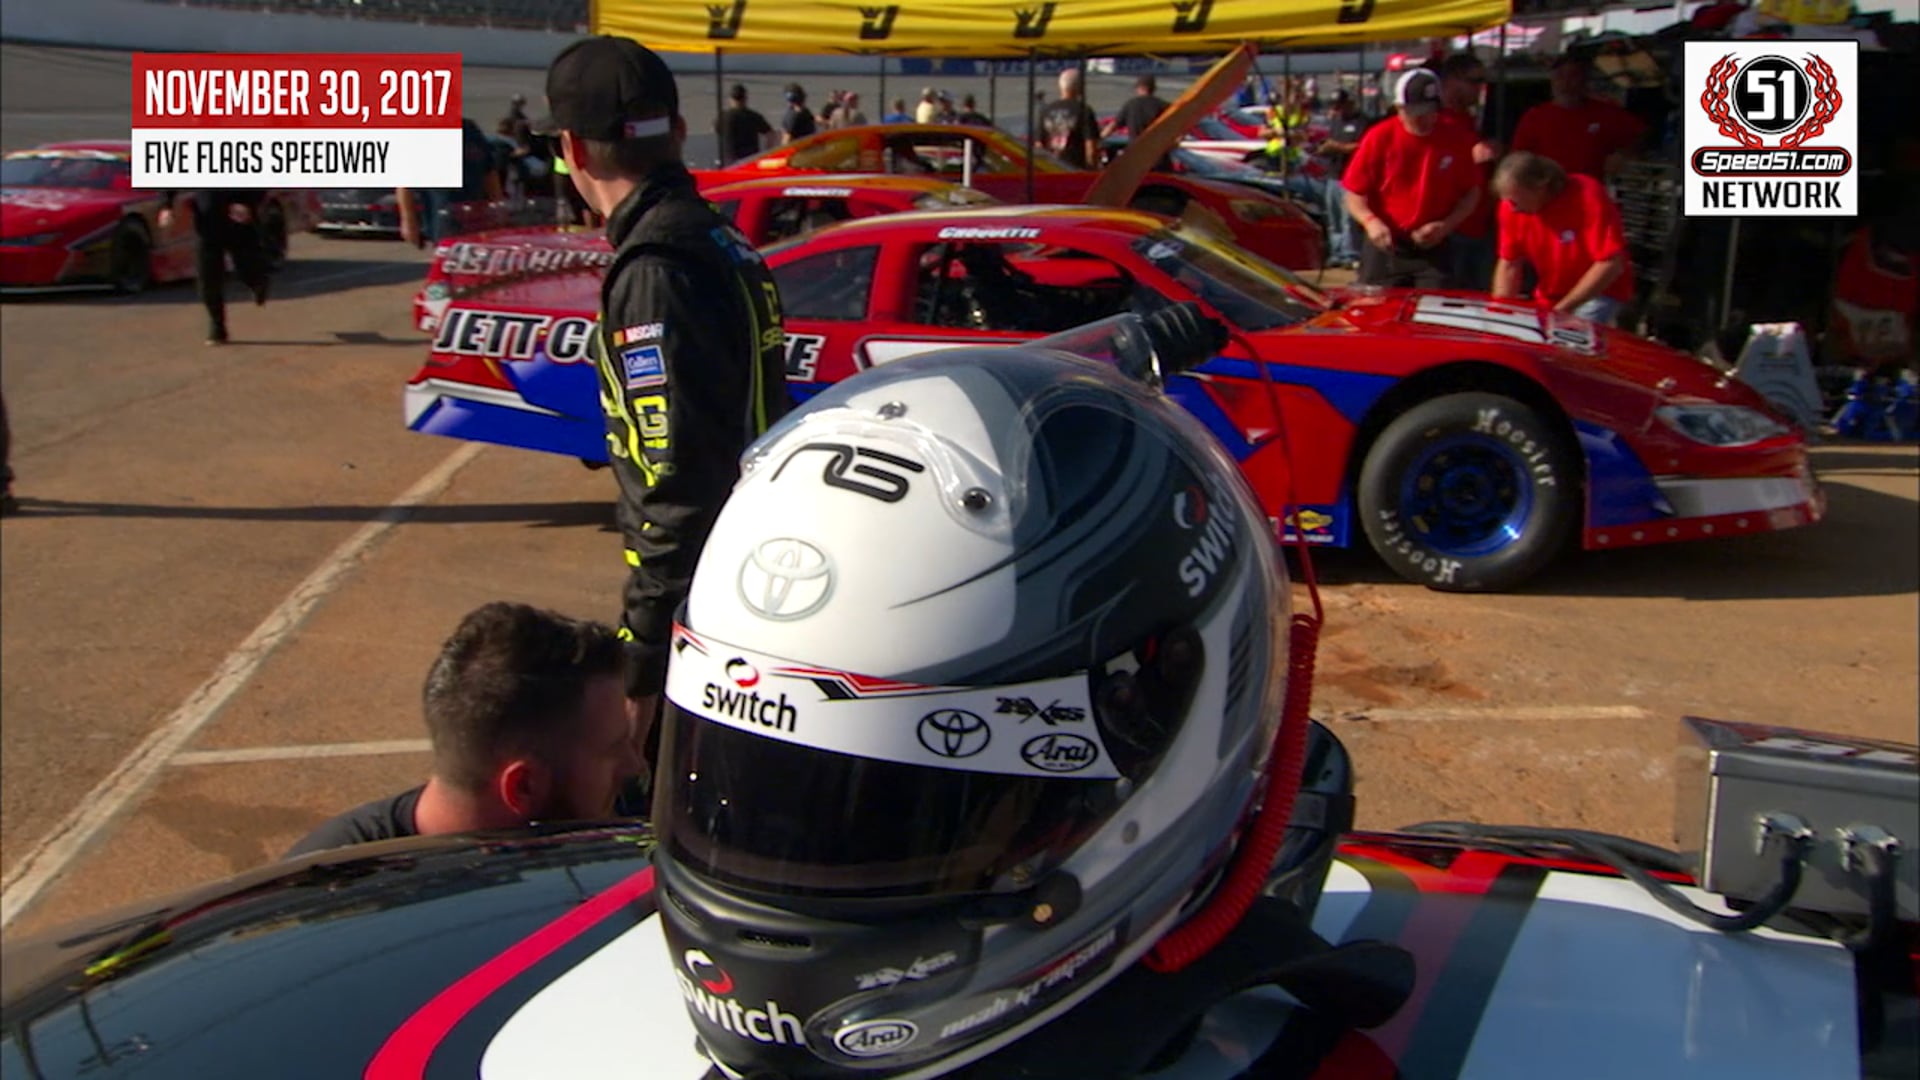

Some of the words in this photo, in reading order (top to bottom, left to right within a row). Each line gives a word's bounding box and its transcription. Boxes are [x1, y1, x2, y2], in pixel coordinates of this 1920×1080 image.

[432, 307, 552, 360] JETT
[624, 322, 665, 344] NASCAR
[1470, 408, 1557, 487] Hoosier
[1379, 508, 1463, 584] Hoosier
[702, 681, 797, 733] switch
[676, 966, 808, 1047] switch
